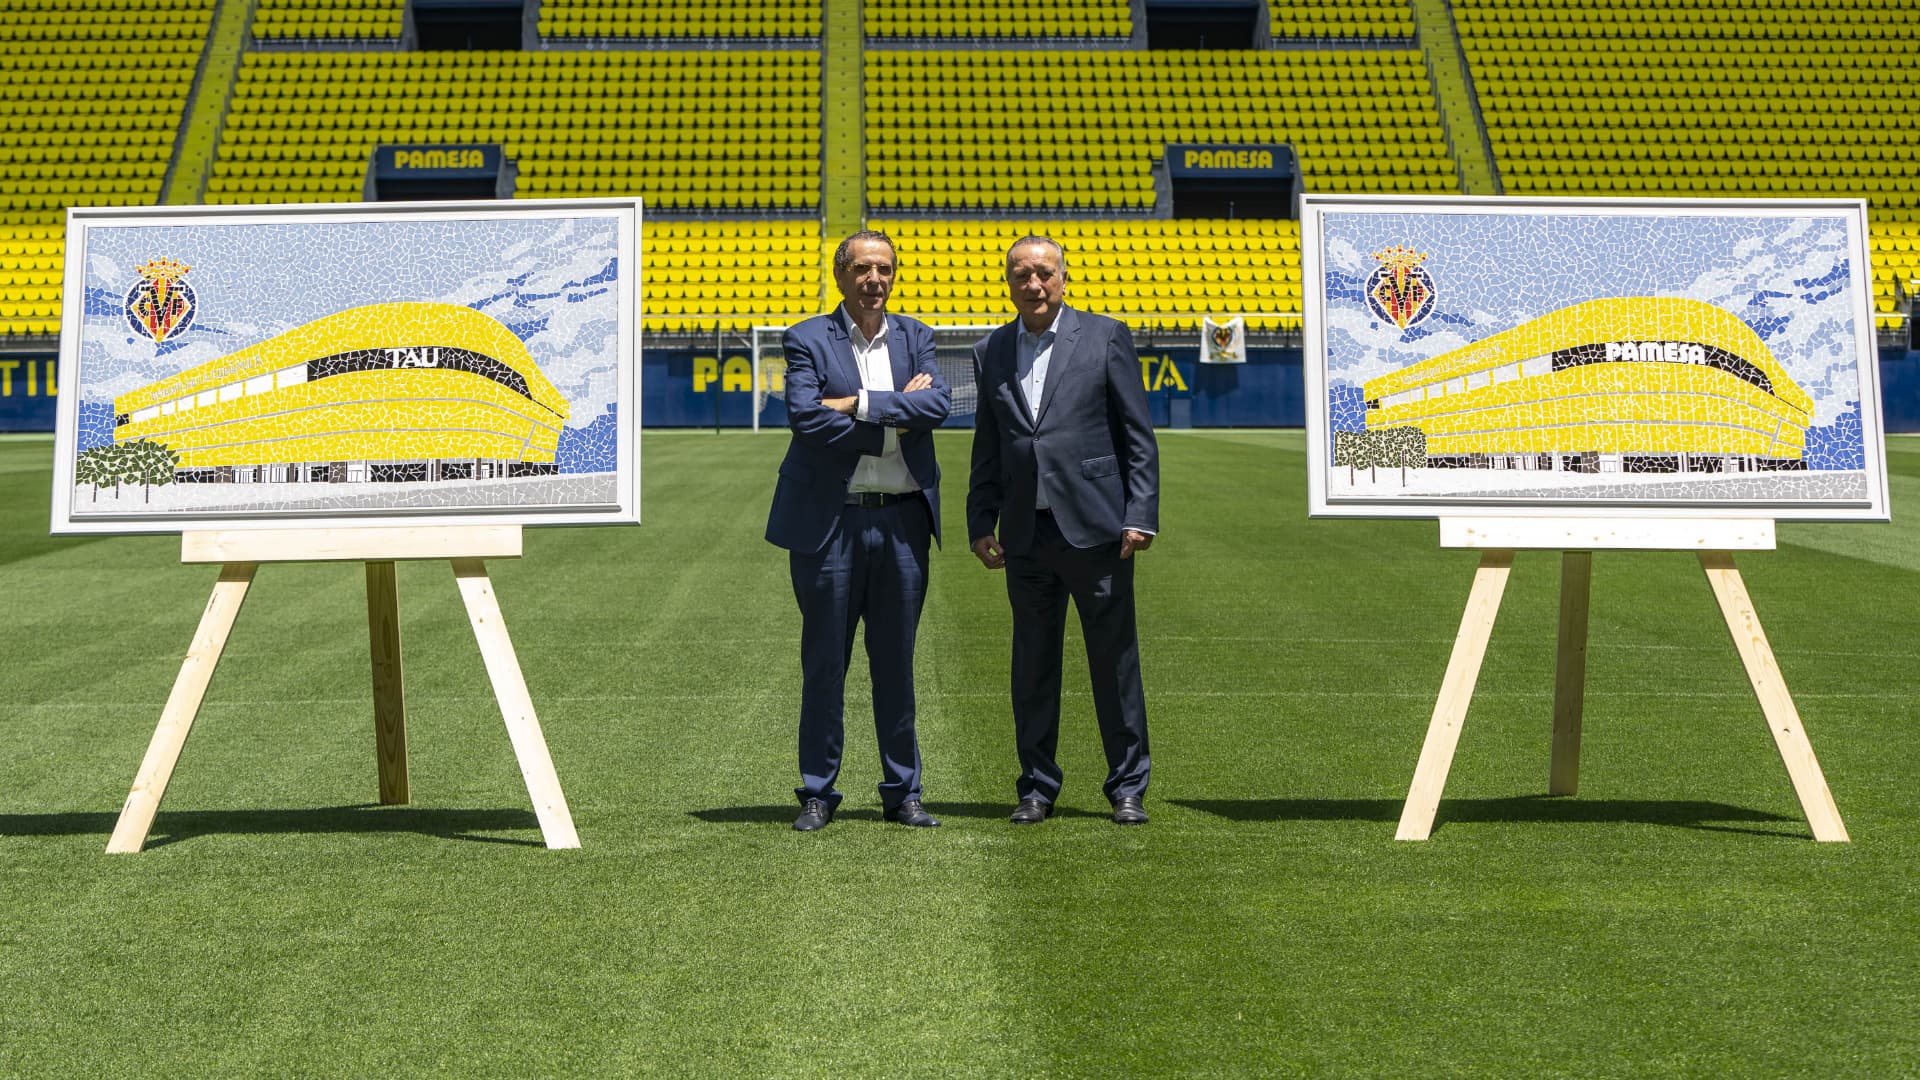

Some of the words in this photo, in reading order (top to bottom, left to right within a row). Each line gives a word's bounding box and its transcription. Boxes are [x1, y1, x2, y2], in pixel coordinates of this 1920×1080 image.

[394, 150, 485, 169] PAMESA
[1184, 150, 1273, 169] PAMESA
[384, 347, 440, 369] TAU
[1605, 341, 1706, 365] PAMESA
